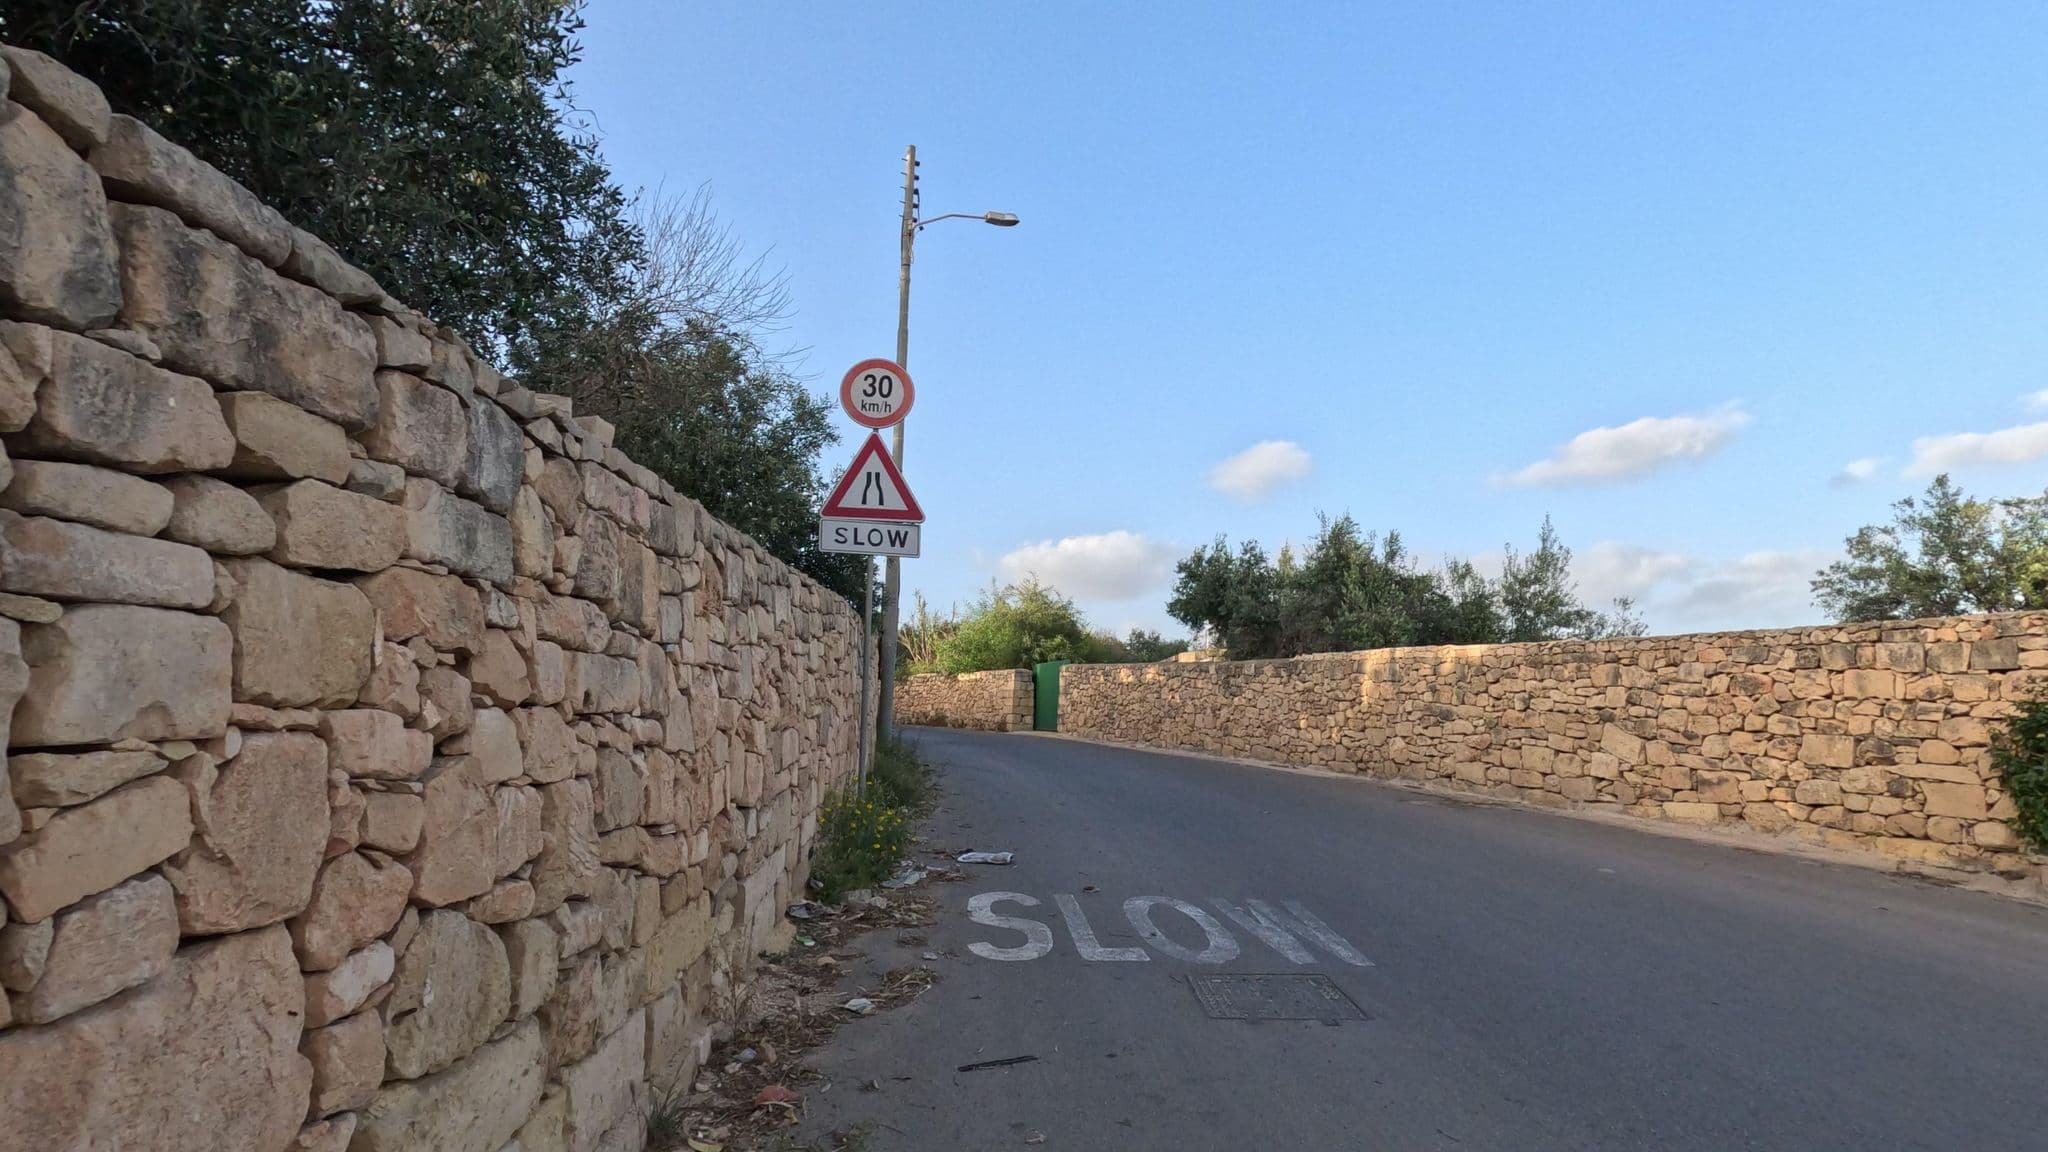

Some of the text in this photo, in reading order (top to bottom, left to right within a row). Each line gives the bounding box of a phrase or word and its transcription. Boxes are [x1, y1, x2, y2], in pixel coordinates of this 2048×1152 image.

[863, 374, 893, 398] 30
[861, 400, 892, 413] km/h
[834, 527, 909, 548] SLOW
[967, 891, 1376, 967] SLOW
